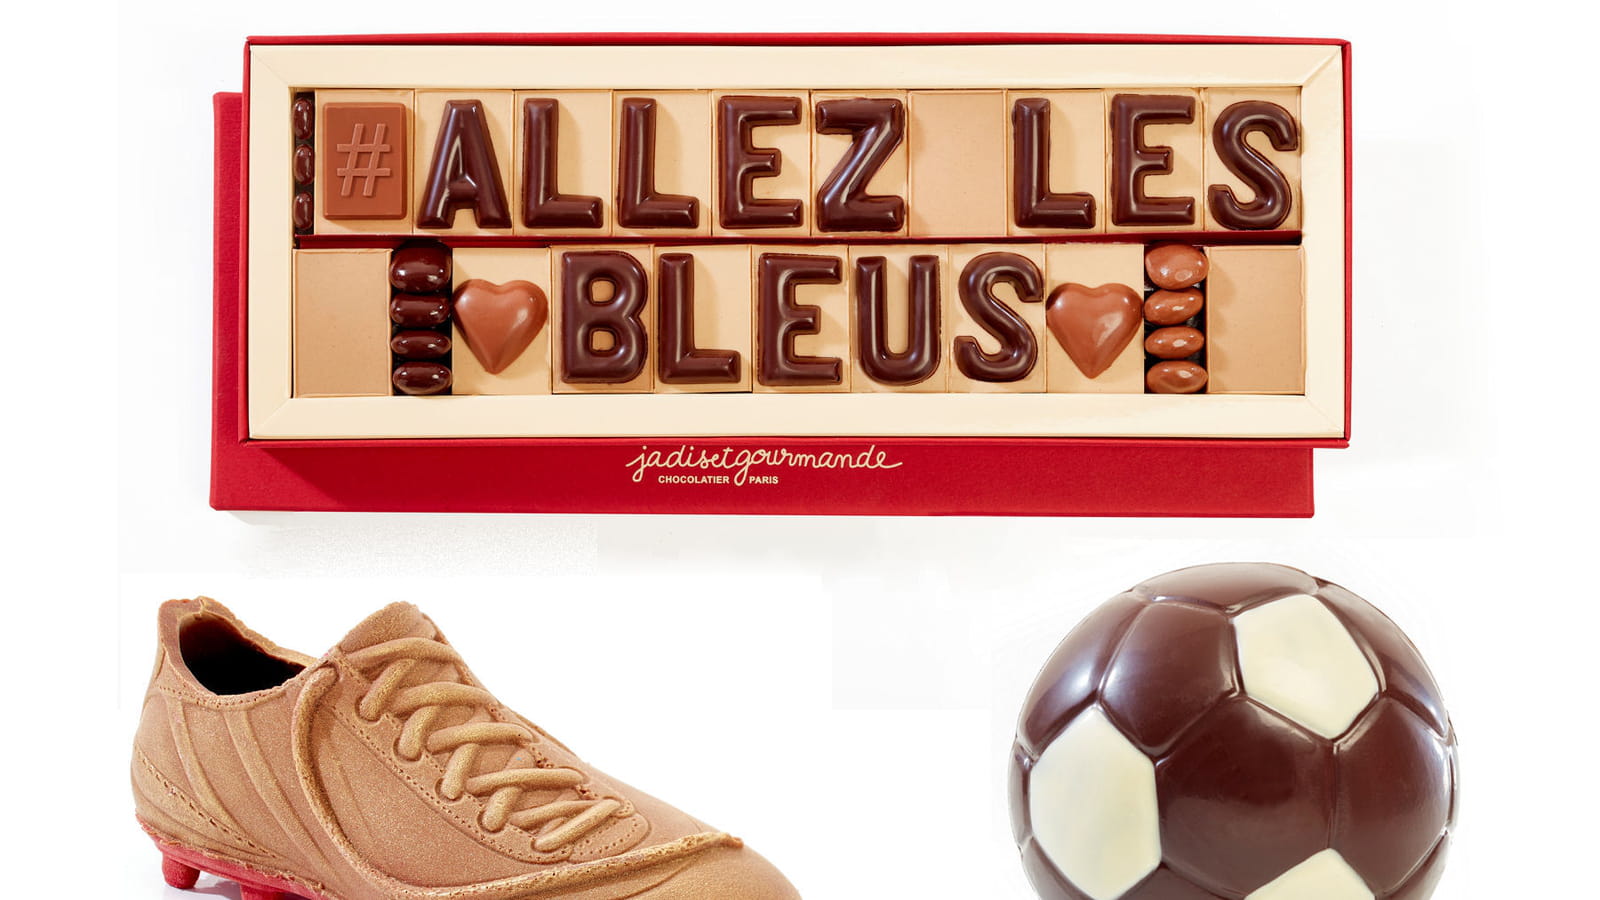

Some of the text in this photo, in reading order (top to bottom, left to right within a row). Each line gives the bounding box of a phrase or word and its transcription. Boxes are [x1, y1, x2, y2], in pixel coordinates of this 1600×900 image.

[1013, 94, 1299, 231] LES
[561, 250, 1045, 386] BLEUS
[658, 475, 779, 485] CHOCOLATIER PARIS
